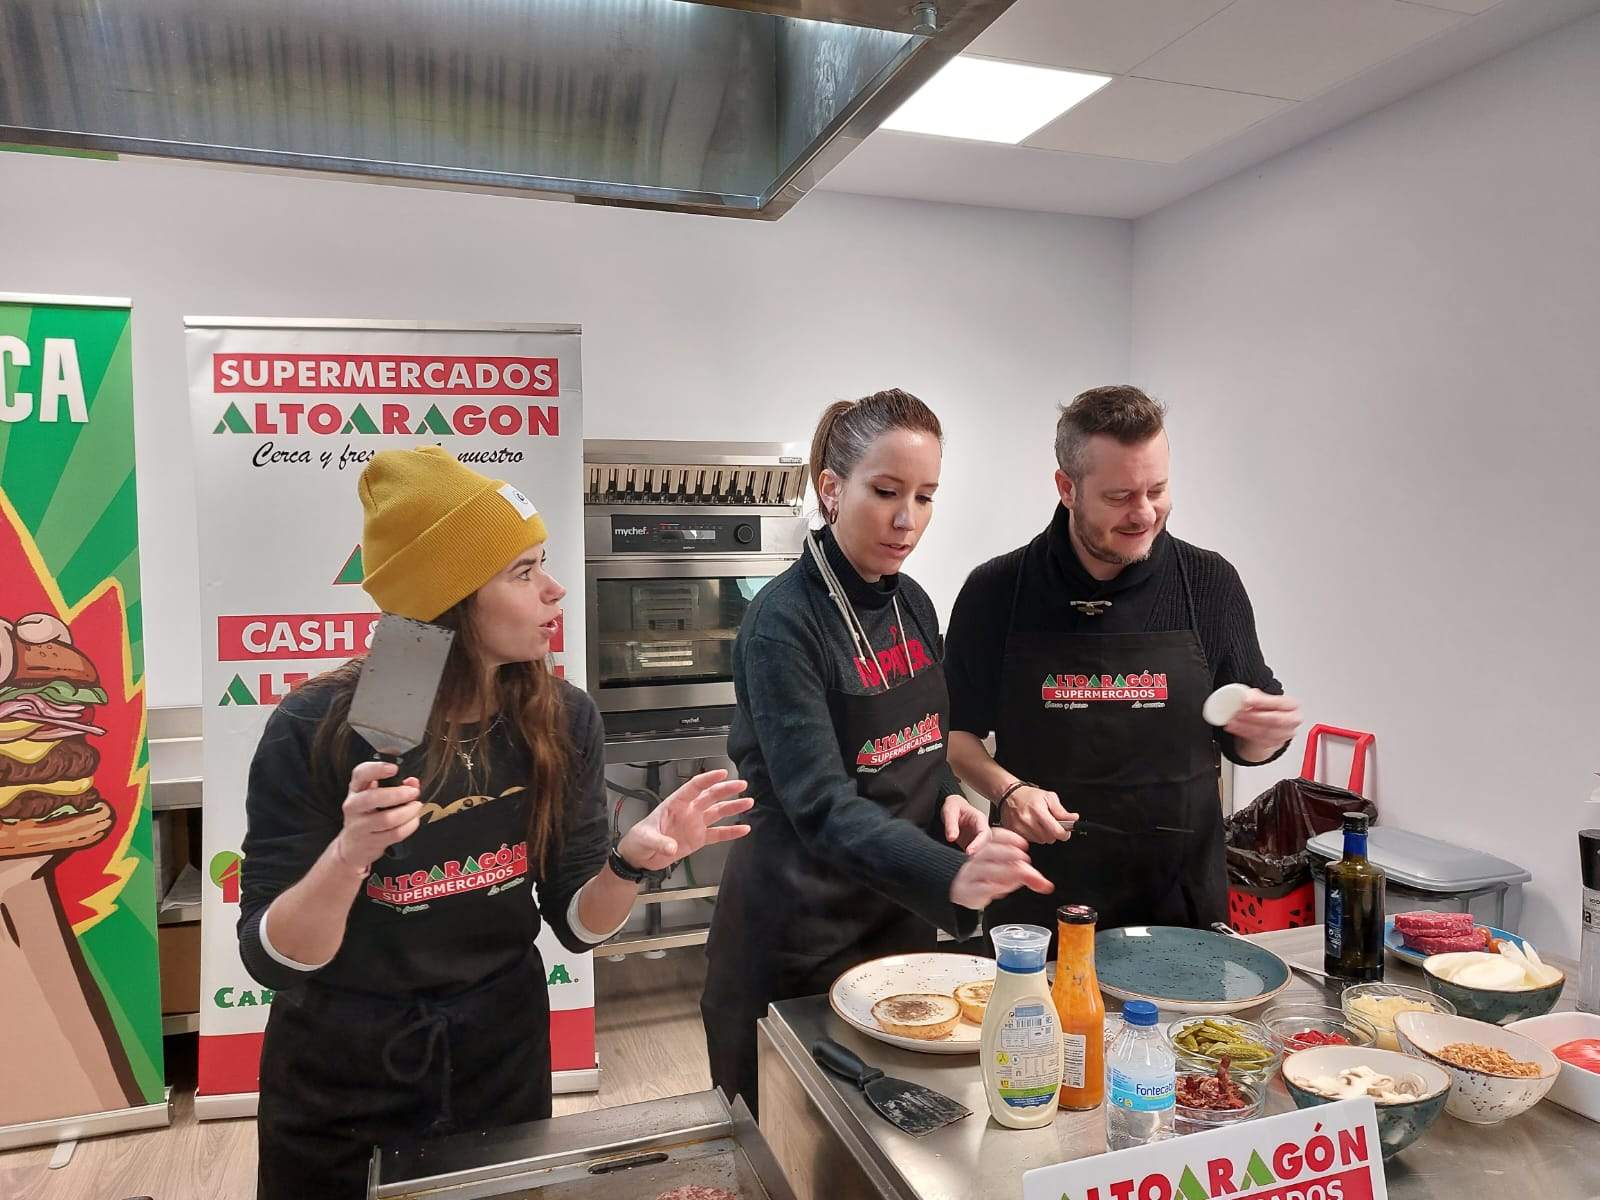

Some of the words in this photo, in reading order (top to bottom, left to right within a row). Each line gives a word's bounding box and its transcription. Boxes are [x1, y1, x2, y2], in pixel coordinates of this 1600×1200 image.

[220, 359, 553, 390] SUPERMERCADOS
[213, 401, 559, 436] ALTOARAGON
[252, 441, 312, 468] Cerca
[319, 450, 333, 469] y
[241, 620, 353, 653] CASH
[1042, 669, 1167, 688] ALTOARAGÓN
[1054, 690, 1156, 698] SUPERMERCADOS
[870, 731, 932, 764] SUPERMERCADOS
[368, 842, 528, 890] ALTOARAGÓN
[382, 865, 514, 902] SUPERMERCADOS
